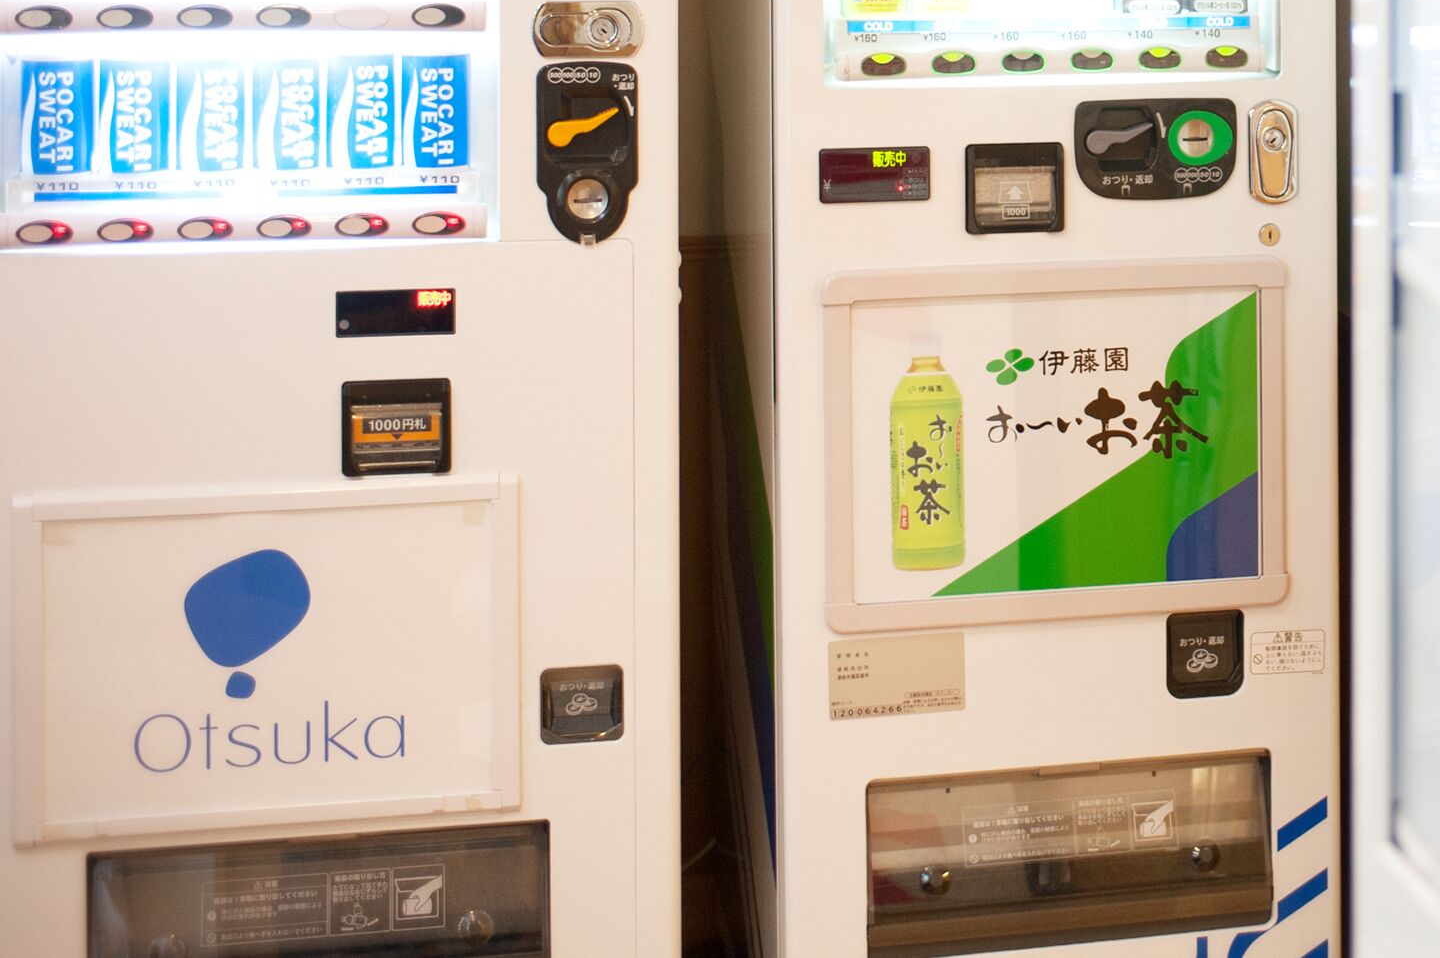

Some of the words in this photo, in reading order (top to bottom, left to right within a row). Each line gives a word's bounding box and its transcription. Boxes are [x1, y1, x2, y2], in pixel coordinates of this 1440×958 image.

[864, 22, 894, 31] COLD
[1206, 17, 1234, 27] COLD
[853, 33, 878, 43] ¥160
[923, 32, 947, 42] ¥160
[1128, 29, 1153, 39] ¥140
[1195, 28, 1221, 38] ¥140
[611, 73, 635, 82] おつり
[355, 65, 374, 156] SWEAT
[372, 65, 388, 164] POCARI
[421, 68, 438, 158] SWEAT
[39, 71, 57, 163] SWEAT
[56, 71, 74, 172] POCARI
[117, 70, 136, 163] SWEAT
[134, 70, 152, 171] POCARI
[438, 68, 454, 165] POCARI
[872, 150, 907, 168] 販売中
[419, 175, 460, 184] ¥110
[1102, 174, 1154, 185] おつり・返却
[1211, 170, 1220, 178] 10
[114, 181, 158, 190] ¥110
[344, 176, 385, 185] ¥110
[36, 182, 80, 191] ¥110
[1006, 207, 1026, 217] 1000
[1038, 347, 1129, 376] 伊藤園
[918, 384, 944, 393] 伊藤園
[368, 417, 427, 431] 1000円札
[906, 440, 951, 525] お茶
[1179, 635, 1225, 647] おつり・返却
[134, 700, 407, 773] Otsuka
